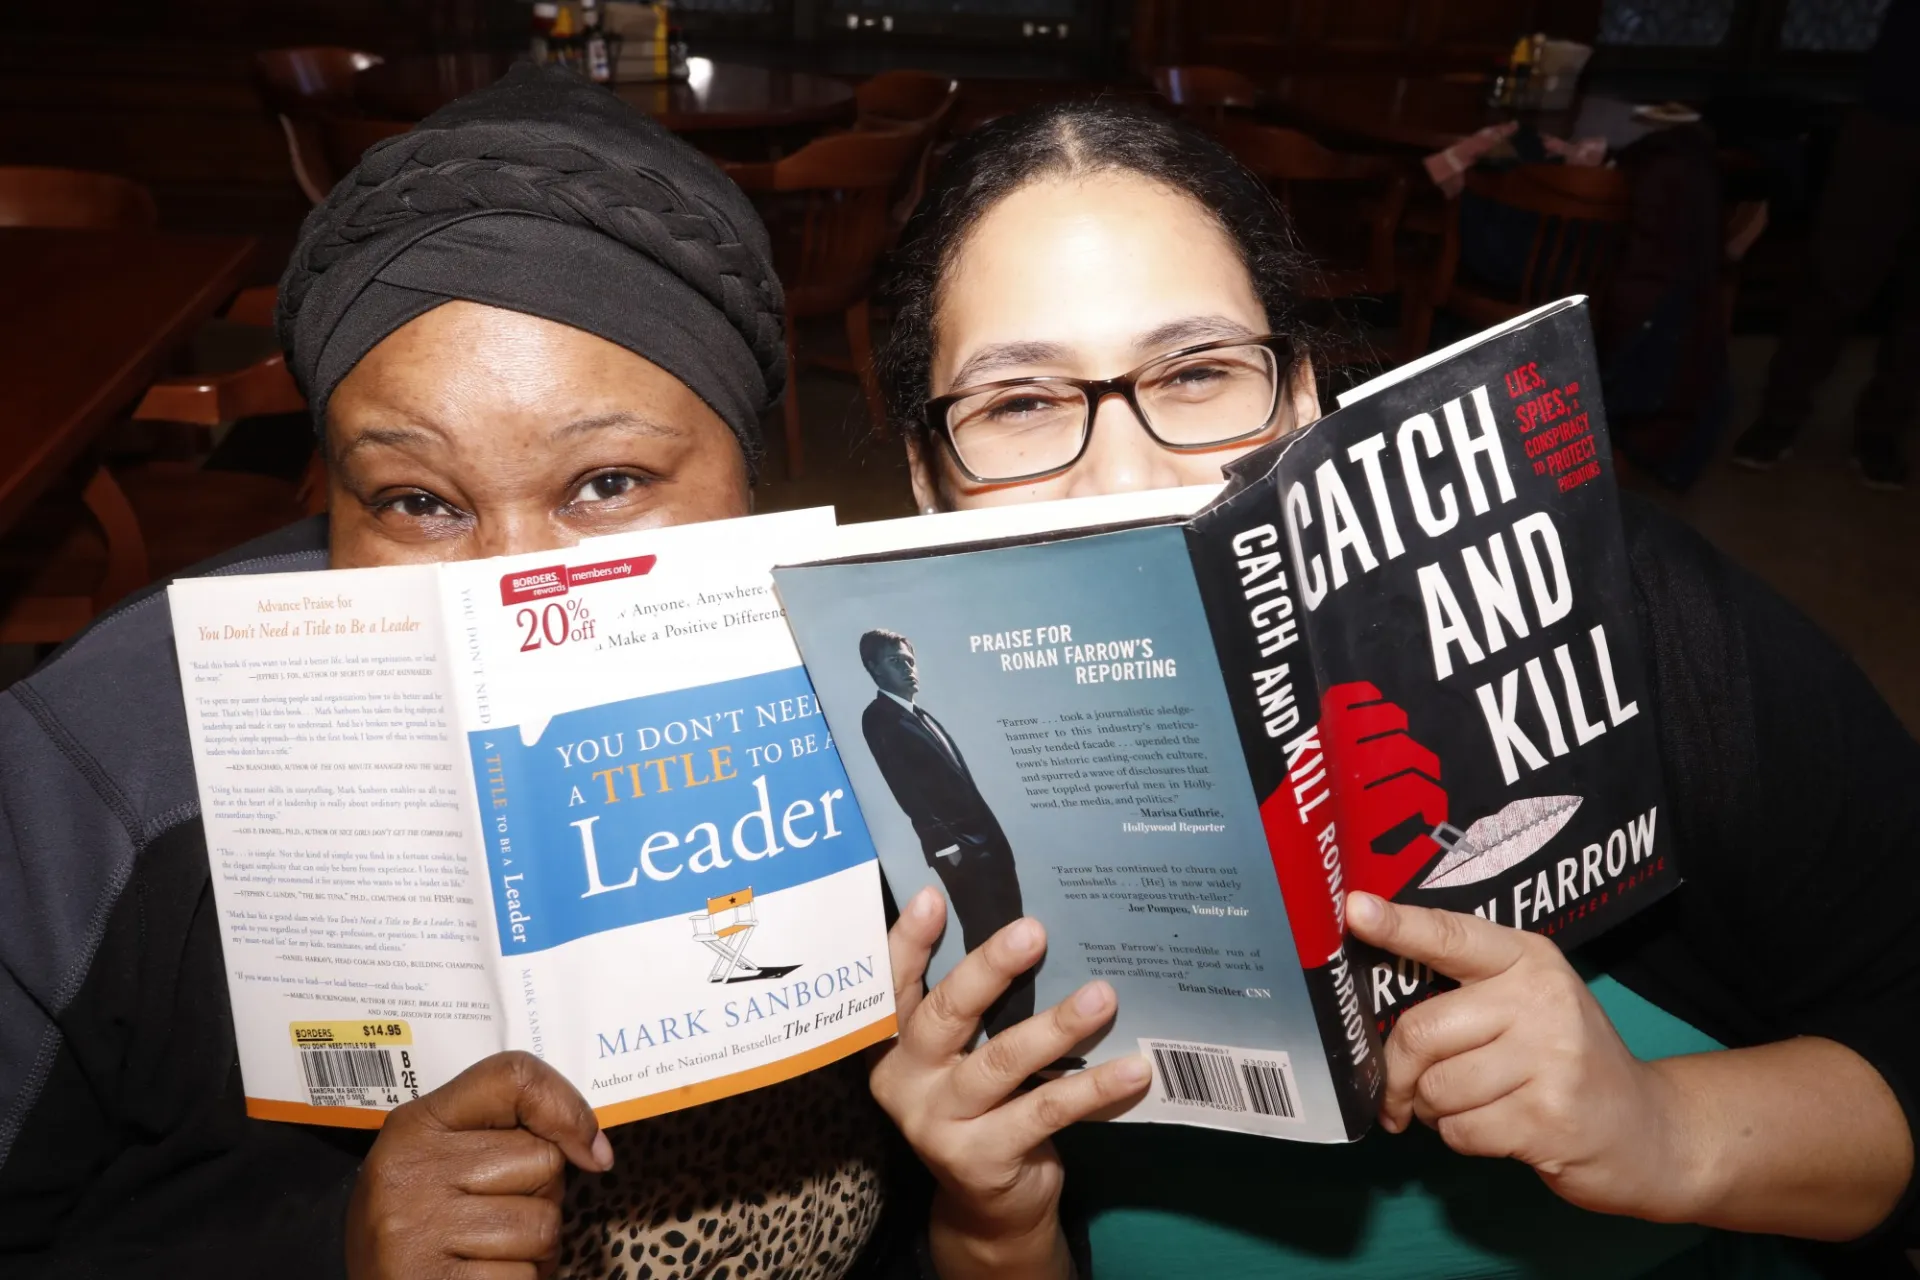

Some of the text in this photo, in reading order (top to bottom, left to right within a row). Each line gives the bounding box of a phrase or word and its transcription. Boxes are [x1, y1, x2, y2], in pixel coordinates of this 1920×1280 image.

[1504, 361, 1547, 399] LIES,
[1516, 388, 1571, 433] SPIES,
[1524, 411, 1590, 458] CONSPIRACY
[1532, 434, 1596, 476] TO PROTECT
[1558, 460, 1601, 493] PREDATORS
[1286, 385, 1517, 612] CATCH
[572, 566, 612, 581] members
[614, 563, 632, 575] only
[533, 584, 566, 596] rewards
[632, 598, 690, 618] Anyone,
[696, 584, 768, 606] Anywhere,
[1232, 522, 1298, 659] CATCH
[1417, 511, 1574, 681] AND
[257, 594, 352, 613] Advance Praise for
[461, 588, 476, 620] YOU
[198, 615, 421, 641] You Don’t Need a Title to Be a Leader
[571, 619, 596, 642] off
[608, 632, 646, 648] Make
[652, 632, 659, 640] a
[664, 620, 718, 638] Positive
[723, 608, 786, 628] Differenc
[970, 624, 1072, 652] PRAISE FOR
[1000, 638, 1154, 672] RONAN FARROW’S
[1076, 659, 1176, 684] REPORTING
[476, 683, 491, 724] NEED
[1060, 712, 1083, 722] took
[1094, 707, 1154, 720] journalistic
[1157, 705, 1194, 716] sledge-
[1252, 665, 1300, 738] AND
[1476, 624, 1640, 786] KILL
[556, 733, 624, 768] YOU
[637, 709, 744, 752] DON’T
[1005, 731, 1049, 742] hammer
[1071, 726, 1092, 736] this
[1156, 720, 1199, 730] meticu-
[484, 741, 494, 750] A
[1010, 735, 1200, 756] lously tended facade upended the
[1050, 756, 1090, 766] historic
[1092, 751, 1163, 763] casting-couch
[1166, 750, 1208, 760] culture,
[486, 754, 508, 810] TITLE
[568, 785, 586, 807] A
[592, 745, 738, 804] TITLE
[746, 742, 782, 768] TO
[790, 734, 818, 758] BE
[1022, 764, 1209, 782] and spurred wave disclosures that
[1282, 724, 1330, 825] KILL
[1025, 780, 1216, 796] have toppled powerful men Holly-
[1031, 800, 1060, 809] wood,
[1061, 799, 1078, 808] the
[1080, 797, 1113, 806] media,
[1116, 796, 1134, 804] and
[1179, 808, 1224, 818] Guthrie,
[496, 815, 508, 832] TO
[1122, 822, 1225, 834] Hollywood Reporter
[500, 838, 512, 853] BE
[570, 775, 844, 899] Leader
[503, 858, 512, 866] A
[1095, 865, 1113, 873] has
[1116, 864, 1168, 873] continued
[1185, 866, 1216, 874] churn
[1220, 866, 1238, 874] out
[1514, 806, 1657, 929] FARROW
[1059, 878, 1116, 887] bombshells
[1140, 878, 1164, 888] [He]
[1206, 880, 1241, 890] widely
[1617, 856, 1664, 895] PRIZE
[504, 873, 531, 943] Leader
[1065, 892, 1088, 900] seen
[1110, 892, 1167, 900] courageous
[1146, 904, 1190, 914] Pompeo,
[1192, 905, 1225, 917] Vanity
[1227, 906, 1249, 916] Fair
[1086, 956, 1251, 970] reporting proves that good work
[1169, 944, 1220, 956] incredible
[1226, 949, 1244, 957] run
[1128, 968, 1160, 978] calling
[522, 968, 536, 1006] MARK
[1208, 986, 1245, 998] Stelter,
[1246, 988, 1271, 998] CNN
[596, 956, 874, 1059] MARK SANBORN
[1327, 943, 1370, 1066] FARROW
[363, 1024, 402, 1036] $14.95
[591, 990, 885, 1090] Author of the National Bestseller The Fred Factor
[400, 1051, 410, 1068] B
[402, 1071, 418, 1088] 2E
[386, 1095, 399, 1104] 44
